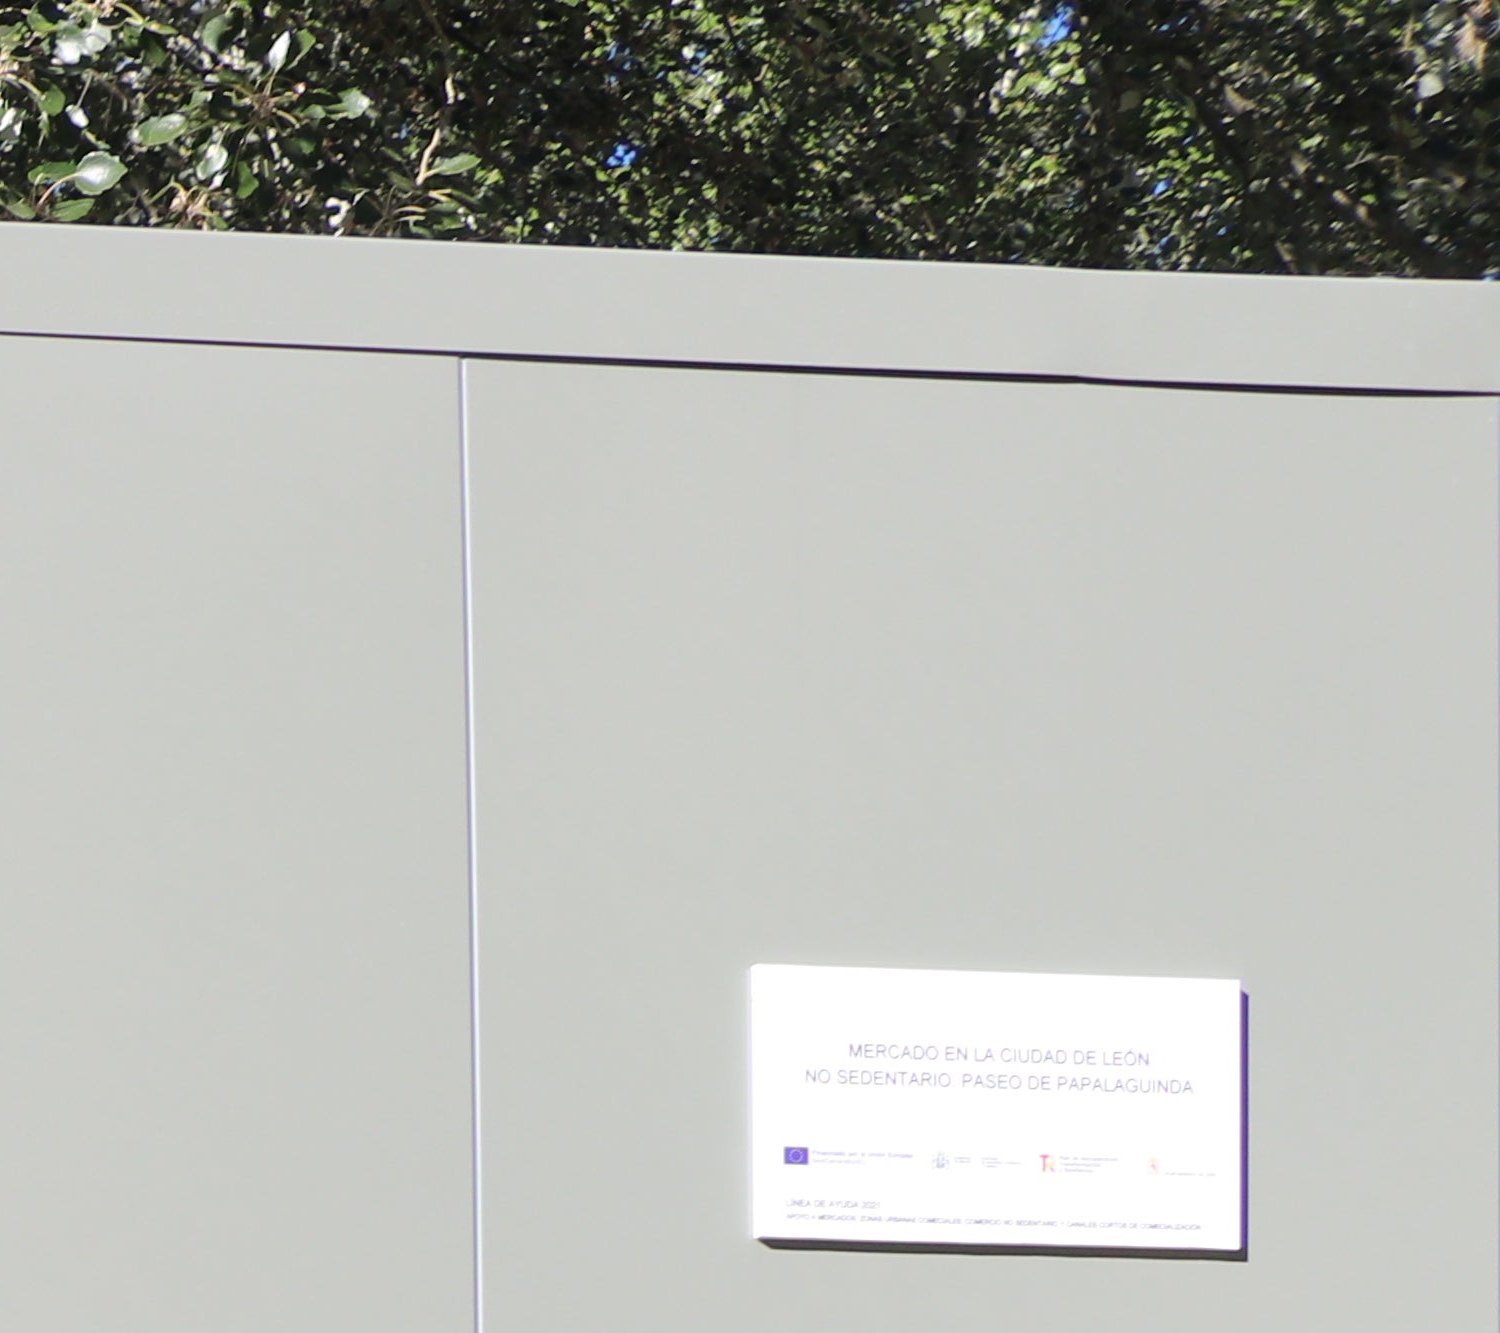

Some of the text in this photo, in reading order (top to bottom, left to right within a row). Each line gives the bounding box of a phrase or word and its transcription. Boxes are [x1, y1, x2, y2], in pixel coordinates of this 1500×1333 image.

[849, 1044, 1150, 1066] MERCADO EN LA CIUDAD DE LEÓN
[805, 1069, 831, 1084] NO
[962, 1073, 1022, 1089] PASEO
[1028, 1075, 1051, 1090] DE
[1057, 1076, 1194, 1094] PAPALAGUINDA
